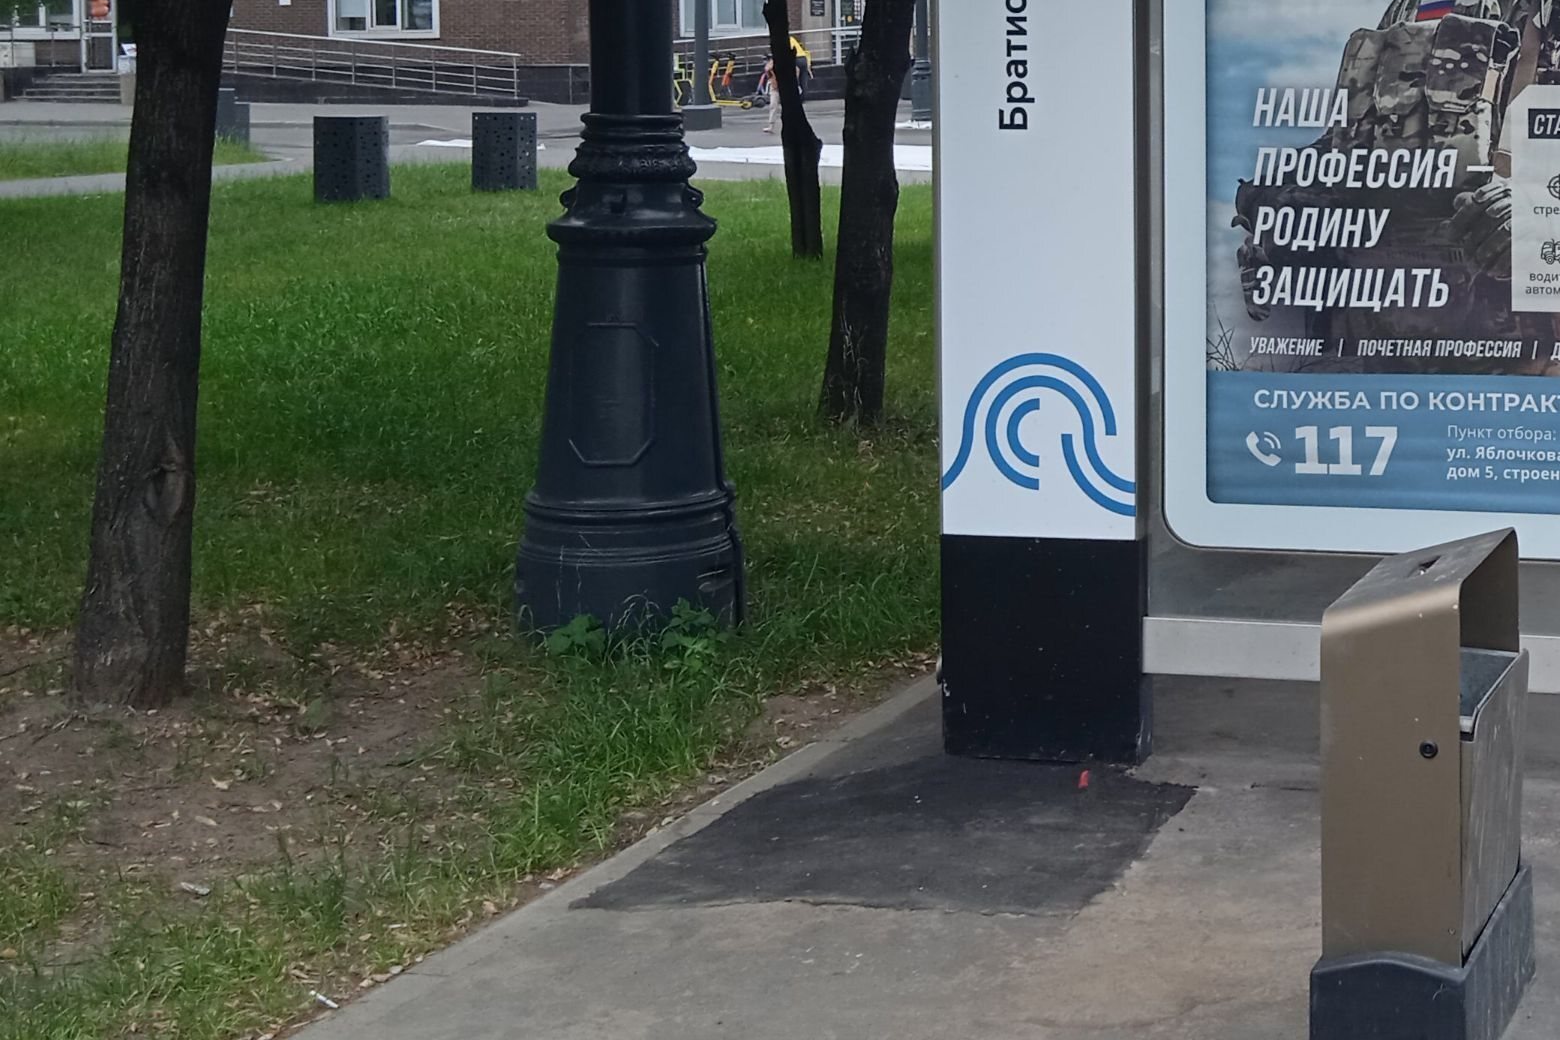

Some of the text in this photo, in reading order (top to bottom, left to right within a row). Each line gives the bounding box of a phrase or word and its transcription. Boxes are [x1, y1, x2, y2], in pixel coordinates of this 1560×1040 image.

[1252, 87, 1349, 128] НАША
[1252, 146, 1458, 189] ПРОФЕССИЯ
[1252, 206, 1390, 252] РОДИНУ
[1252, 265, 1450, 312] ЗАЩИЩАТЬ
[1249, 336, 1324, 356] УВАЖЕНИЕ
[1357, 339, 1522, 358] ПОЧЕТНАЯ ПРОФЕССИЯ
[1253, 389, 1371, 410] СЛУЖБА
[1380, 391, 1420, 410] ПО
[1447, 425, 1557, 442] Пункт отбора:
[1294, 425, 1398, 476] 117
[1446, 448, 1470, 461] ул.
[1446, 466, 1480, 481] дом
[1484, 466, 1499, 481] 5,
